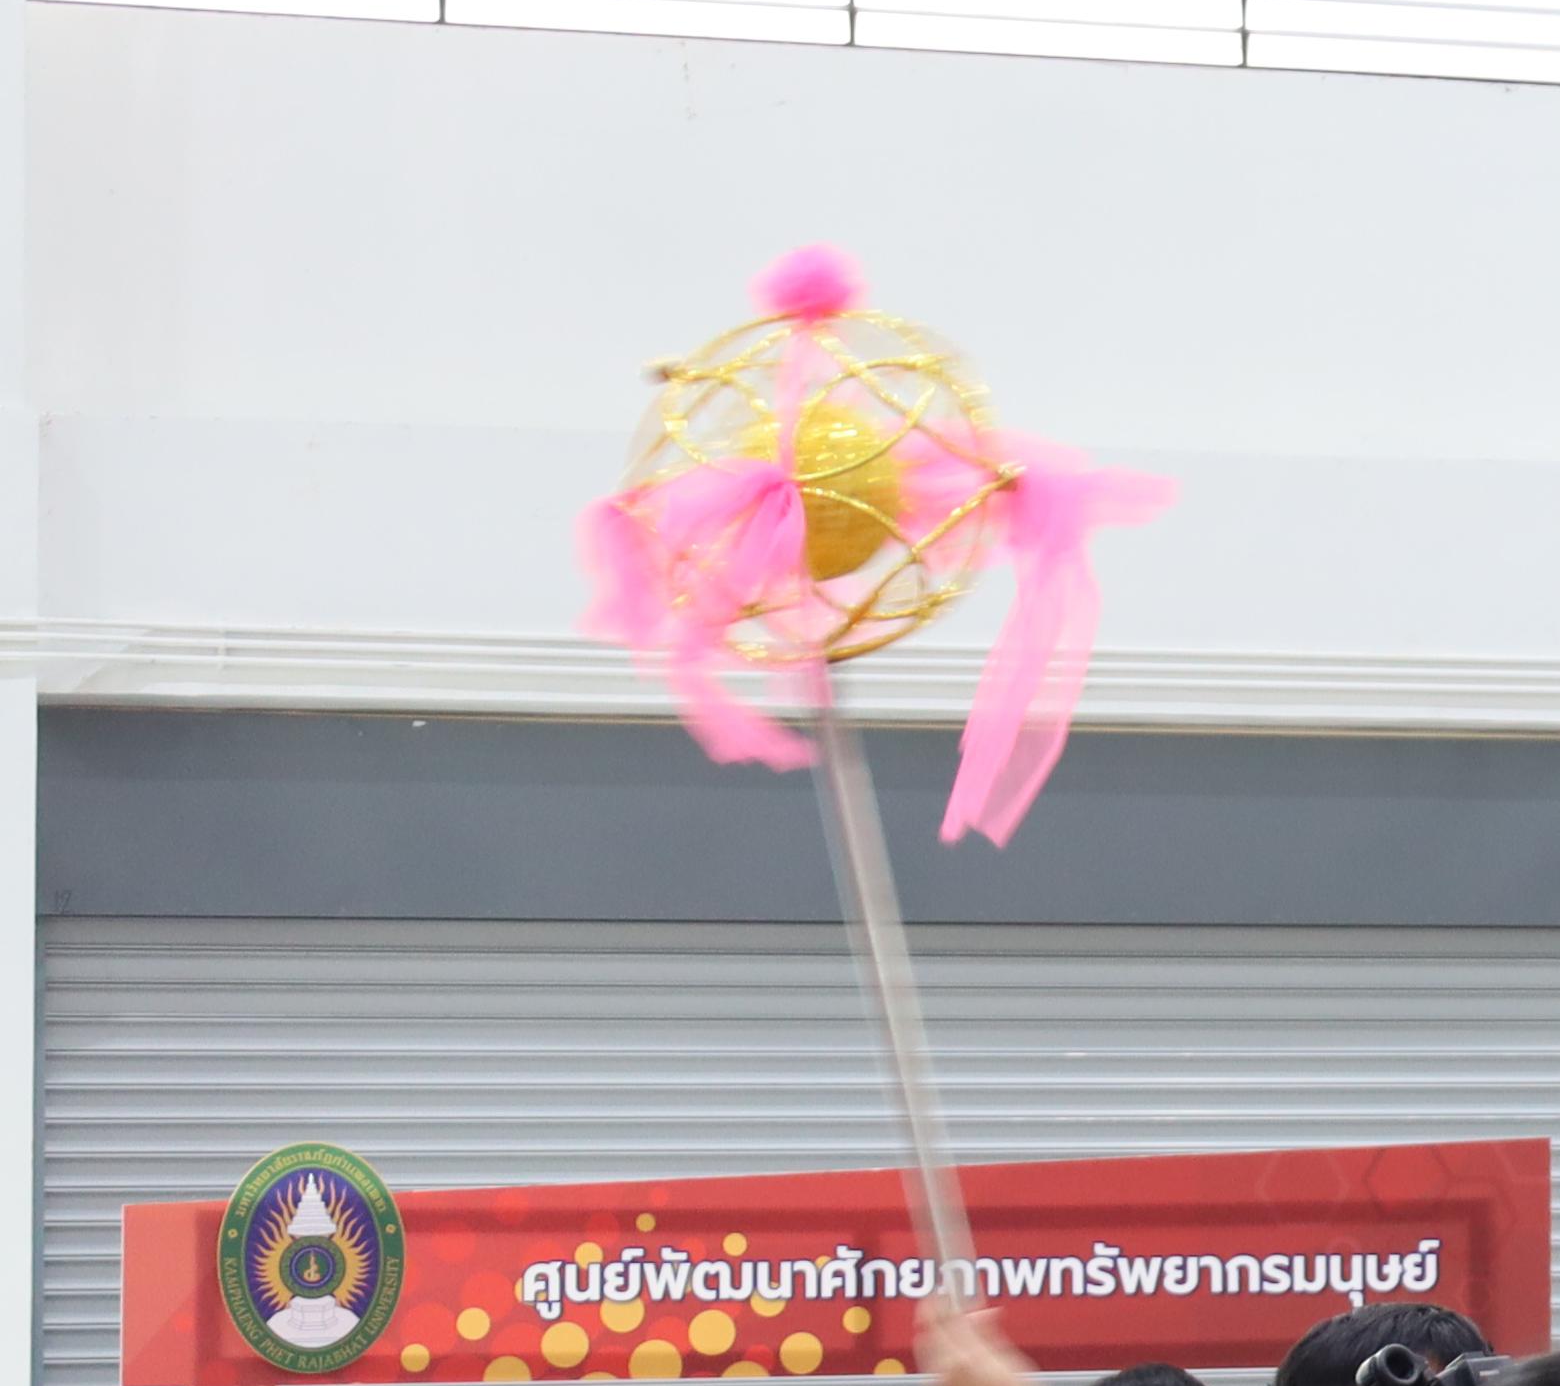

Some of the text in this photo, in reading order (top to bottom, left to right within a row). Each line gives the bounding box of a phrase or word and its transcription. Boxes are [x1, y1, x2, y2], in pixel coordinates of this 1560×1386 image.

[521, 1239, 1440, 1319] ศูนย์พัฒนาศักยภาพทรัพยากรมนุษย์
[261, 1339, 294, 1363] PHET
[298, 1334, 369, 1368] RAJABHAT
